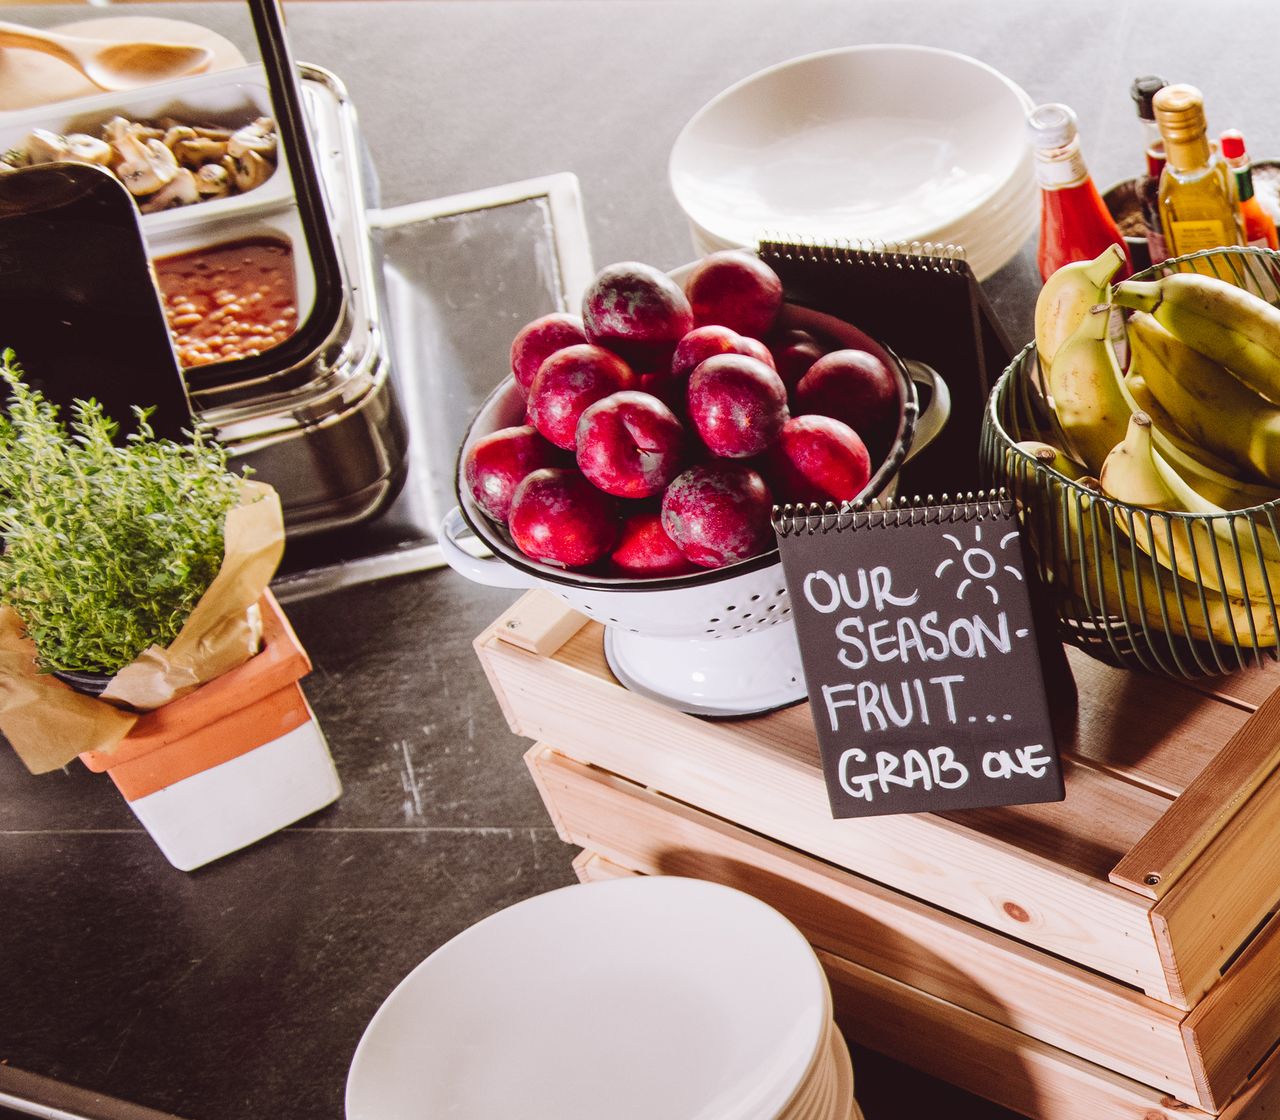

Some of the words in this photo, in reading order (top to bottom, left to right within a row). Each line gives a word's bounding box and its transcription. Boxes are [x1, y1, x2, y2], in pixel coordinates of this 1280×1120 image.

[803, 566, 919, 613] OUR
[838, 745, 968, 802] GRAB
[982, 744, 1052, 780] ONE
